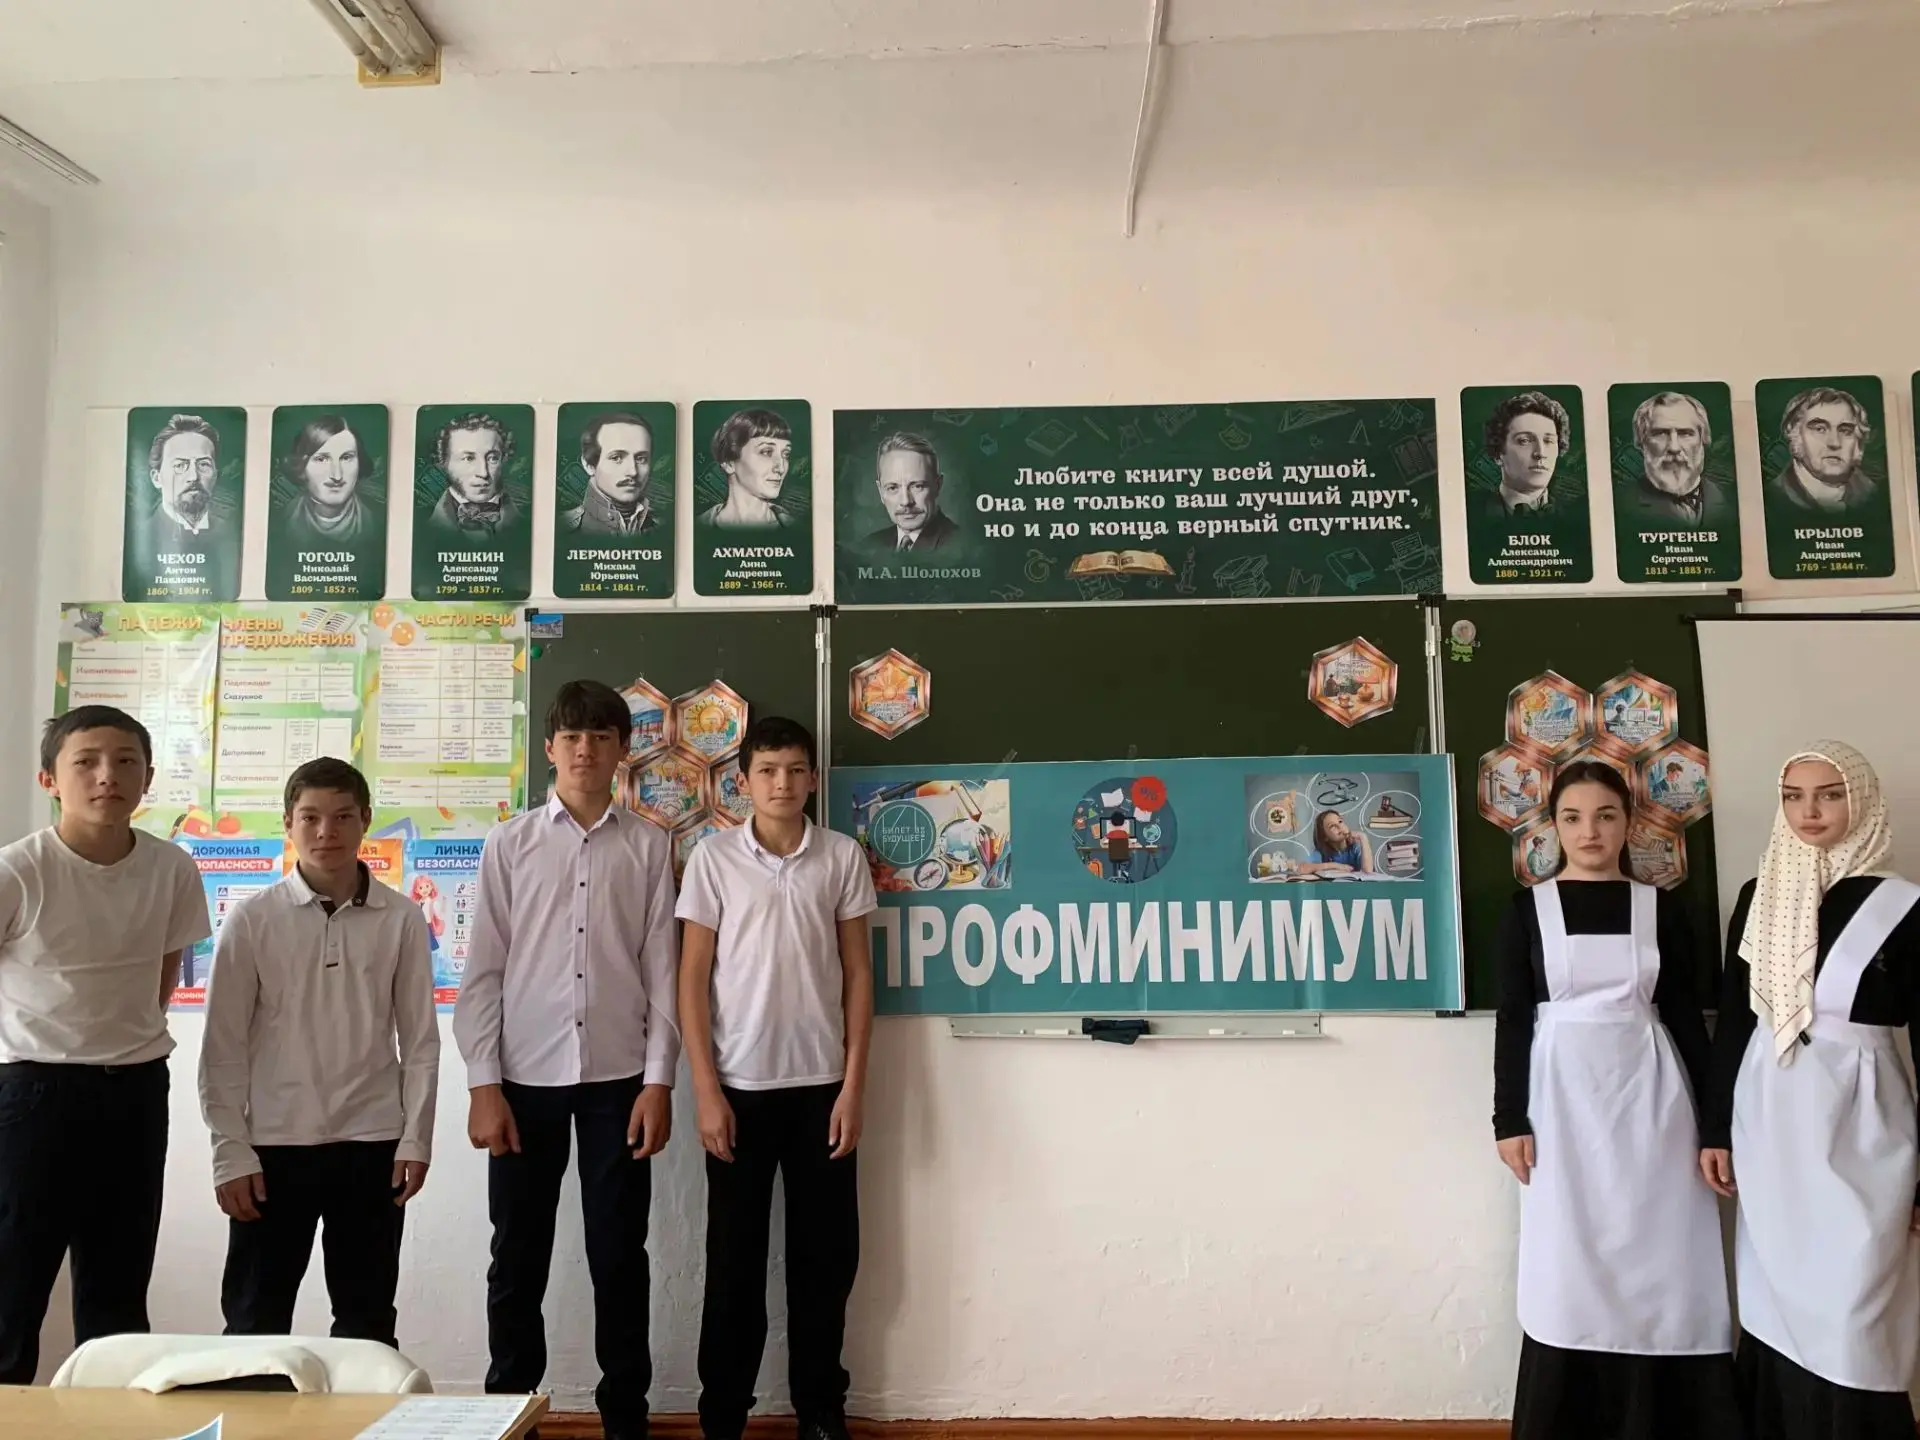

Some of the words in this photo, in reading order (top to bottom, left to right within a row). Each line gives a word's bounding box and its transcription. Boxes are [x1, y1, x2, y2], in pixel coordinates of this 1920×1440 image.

[1014, 467, 1116, 486] Любите
[1126, 466, 1203, 488] книгу
[1212, 462, 1272, 482] всей
[1283, 459, 1376, 484] душой.
[976, 494, 1026, 512] Она
[1036, 495, 1065, 511] не
[1074, 492, 1166, 510] только
[1175, 492, 1228, 508] ваш
[1237, 486, 1342, 511] лучший
[1351, 488, 1418, 509] друг,
[984, 522, 1014, 538] но
[1024, 522, 1040, 536] и
[1050, 522, 1080, 540] до
[1090, 520, 1169, 541] конца
[1178, 513, 1278, 538] верный
[1288, 515, 1411, 536] спутник.
[1638, 532, 1718, 543] ТУРГЕНЕВ
[1794, 527, 1864, 539] КРЫЛОВ
[1508, 535, 1552, 546] БЛОК
[1665, 545, 1694, 553] Иван
[1816, 542, 1844, 550] Иван
[298, 552, 356, 562] ГОГОЛЬ
[438, 552, 504, 562] ПУШКИН
[567, 550, 662, 560] ЛЕРМОНТОВ
[712, 547, 794, 558] АХМАТОВА
[1500, 548, 1560, 557] Александр
[1800, 552, 1862, 560] Андреевич
[157, 554, 206, 564] ЧЕХОВ
[740, 560, 766, 568] Анна
[1488, 558, 1573, 567] Александрович
[1651, 555, 1708, 564] Сергеевич
[164, 566, 196, 574] Антон
[302, 564, 350, 572] Николай
[442, 564, 498, 574] Александр
[594, 562, 636, 570] Михаил
[1645, 567, 1668, 575] 1818
[1680, 566, 1702, 574] 1883
[1830, 562, 1854, 570] 1844
[590, 572, 639, 581] Юрьевич
[724, 570, 782, 580] Андреевна
[858, 566, 898, 579] М.А.
[902, 566, 982, 579] Шолохов
[1496, 570, 1518, 578] 1880
[155, 576, 206, 584] Павлович
[294, 574, 358, 582] Васильевич
[443, 574, 498, 584] Сергеевич
[580, 584, 602, 592] 1814
[612, 584, 634, 592] 1841
[752, 580, 774, 588] 1966
[146, 588, 168, 596] 1860
[291, 586, 313, 594] 1809
[324, 586, 346, 594] 1852
[436, 586, 458, 594] 1799
[468, 586, 490, 594] 1837
[118, 616, 202, 632] ПАДЕЖИ
[222, 618, 284, 632] ЧЛЕНЫ
[416, 614, 467, 628] ЧАСТИ
[473, 614, 516, 627] РЕЧИ
[221, 632, 356, 650] ПРЕДЛОЖЕНИЯ
[192, 846, 260, 857] ДОРОЖНАЯ
[196, 860, 270, 870] ЗОПАСНОСТЬ
[868, 898, 1428, 987] ПРОФМИНИМУМ
